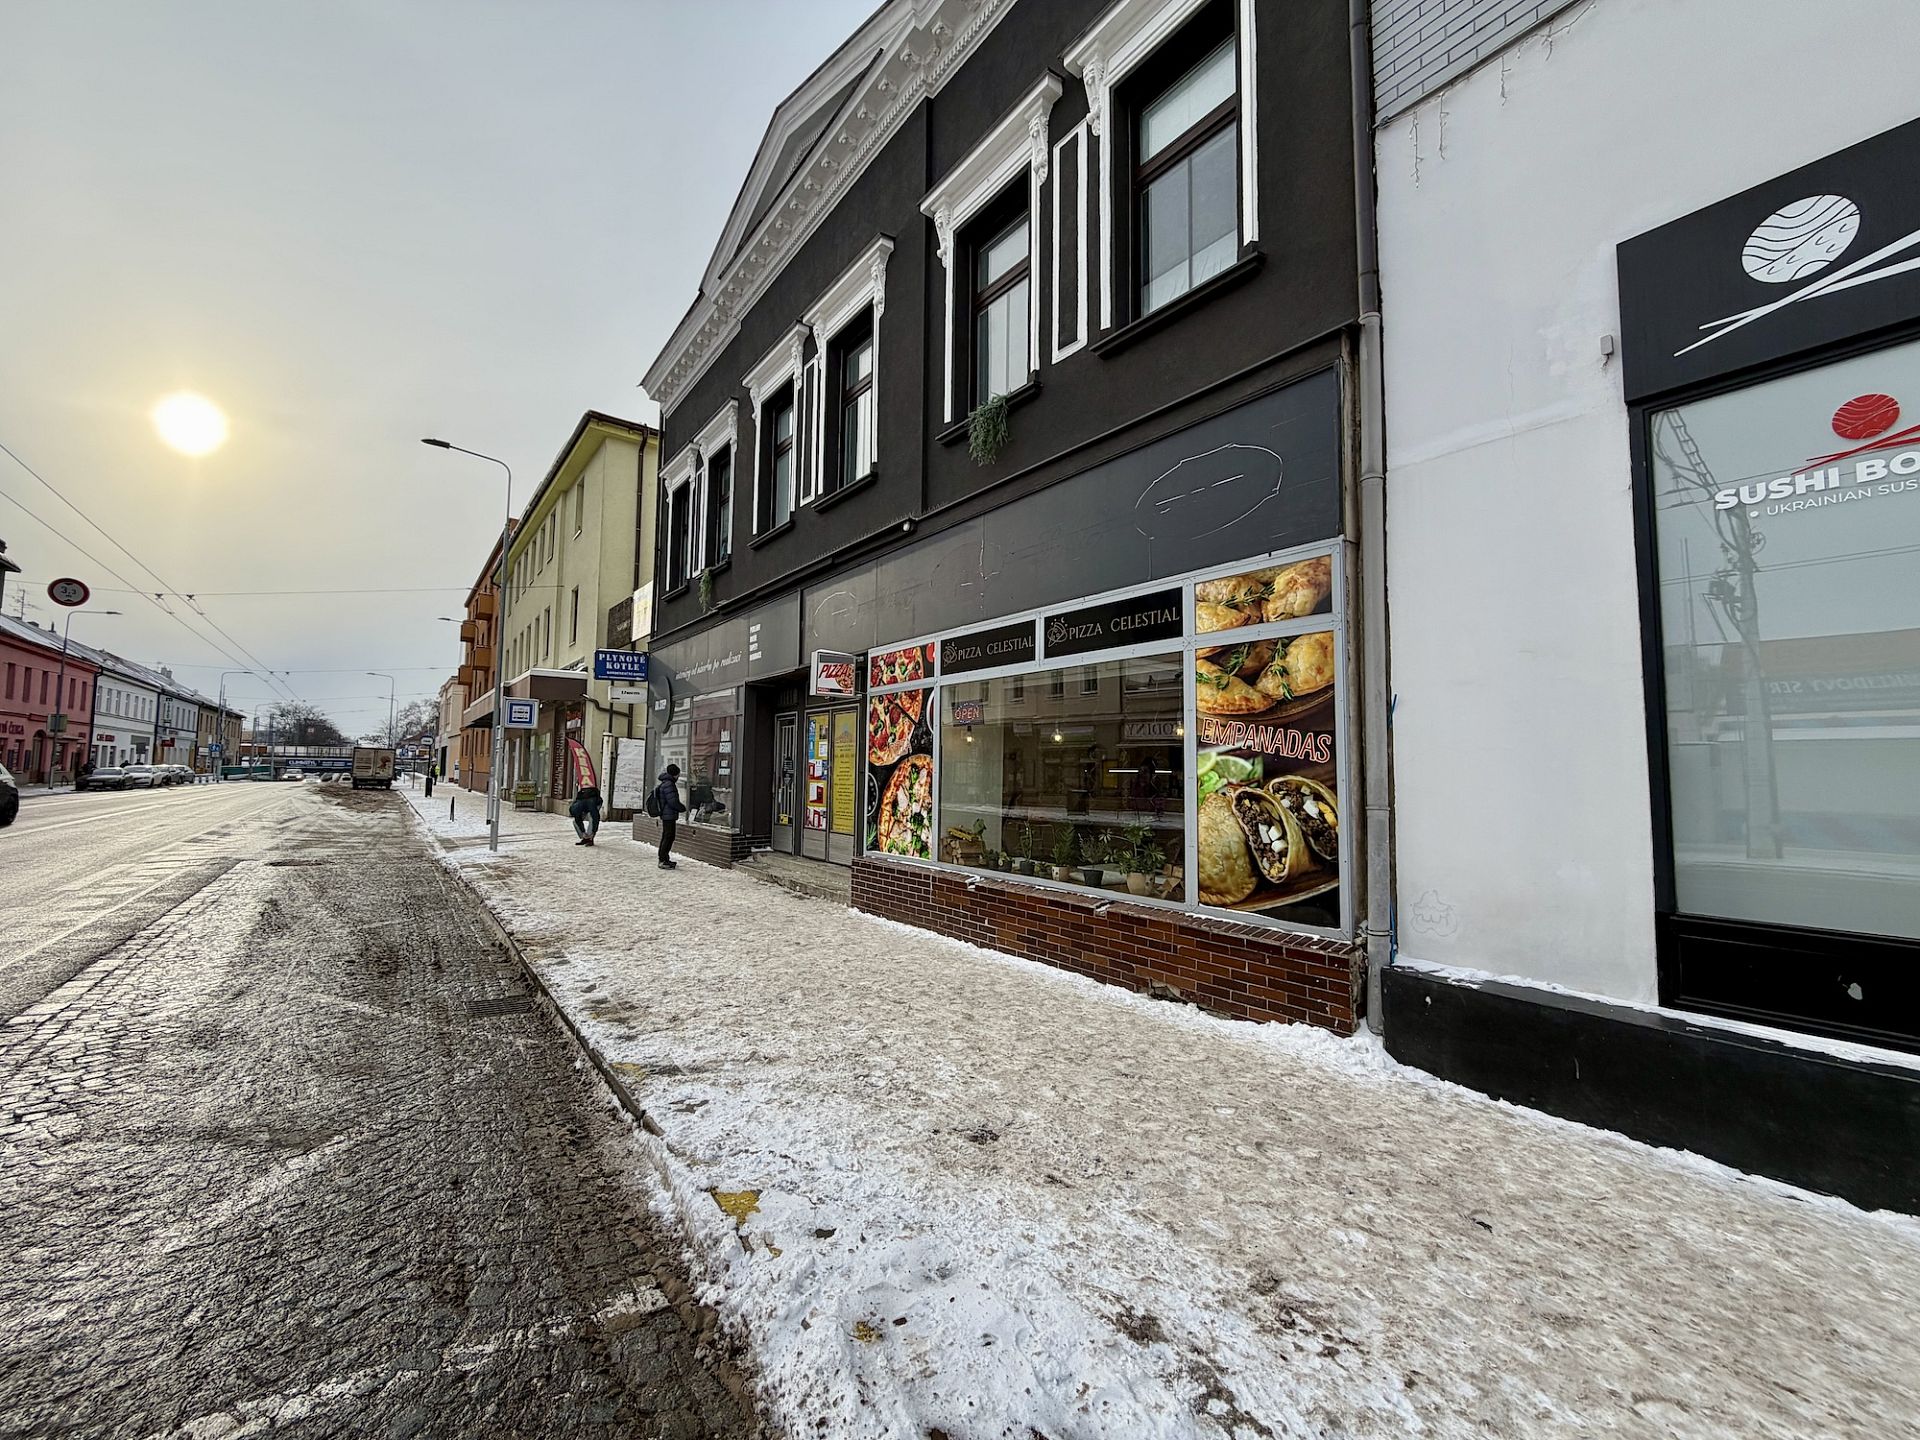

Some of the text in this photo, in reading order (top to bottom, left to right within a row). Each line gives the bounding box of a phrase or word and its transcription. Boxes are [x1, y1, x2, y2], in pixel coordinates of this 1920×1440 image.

[1714, 451, 1920, 510] SUSHI BO
[1767, 479, 1919, 516] UKRAINIAN SUS
[1069, 607, 1180, 641] PIZZA CELESTIAL
[598, 653, 646, 664] PLYNOVÉ
[957, 635, 1034, 661] PIZZA CELESTIAL
[606, 662, 640, 671] KOTLE
[819, 663, 849, 679] PIZZA
[955, 705, 979, 720] OPEN
[1200, 717, 1332, 763] EMPANADAS
